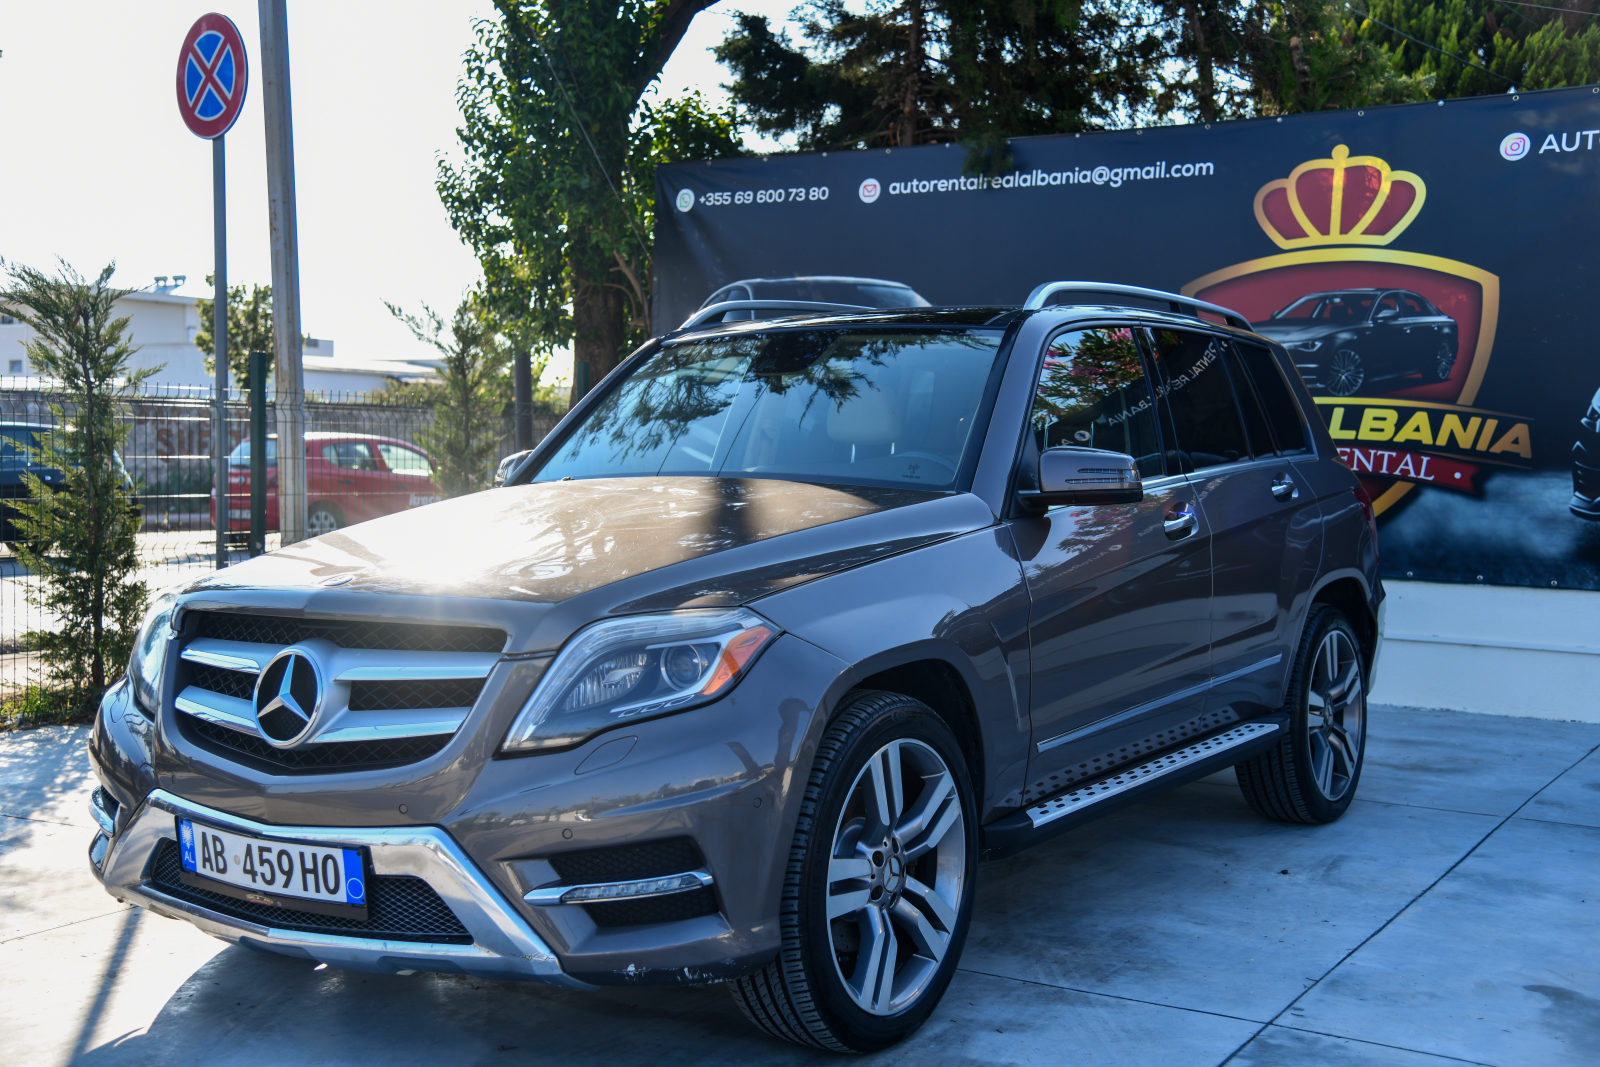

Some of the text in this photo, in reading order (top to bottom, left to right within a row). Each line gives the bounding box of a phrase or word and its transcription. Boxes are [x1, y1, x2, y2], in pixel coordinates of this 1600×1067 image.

[1539, 130, 1600, 154] AUT
[888, 161, 1214, 195] autorentalrealalbania@gmail.com
[699, 186, 829, 206] +355 69 600 73 80
[1329, 407, 1532, 459] LBANIA
[201, 831, 228, 875] AB
